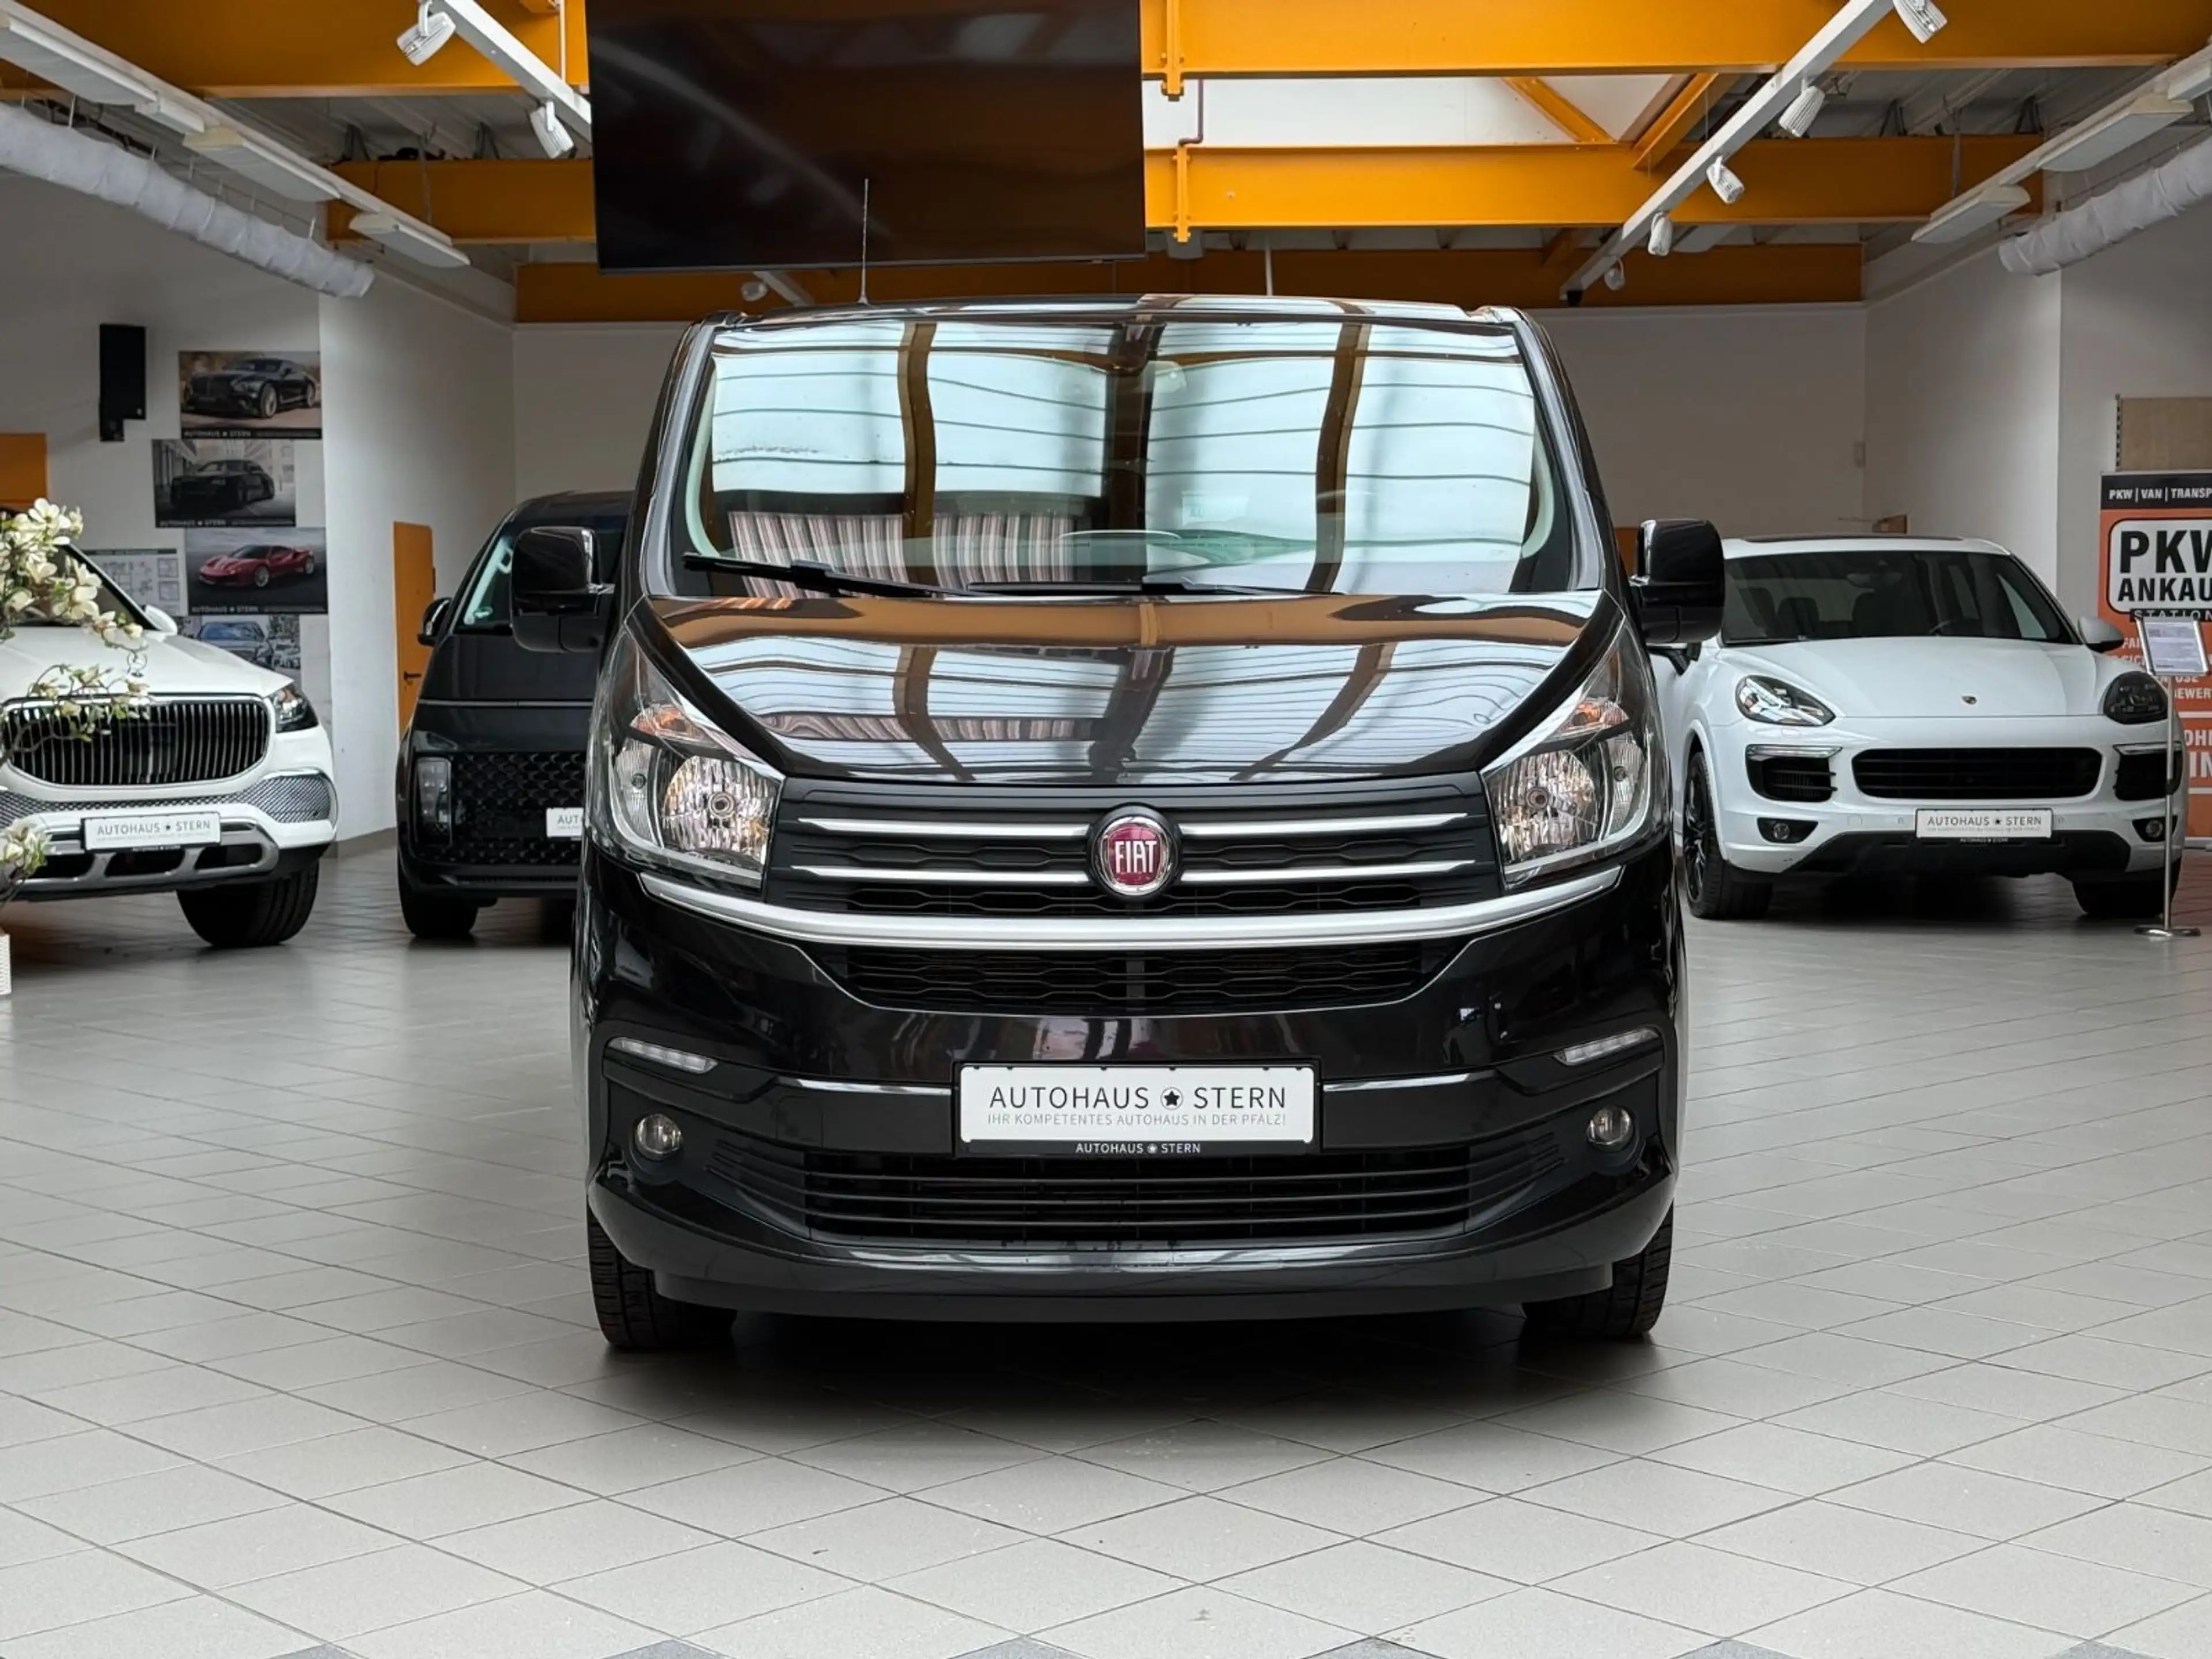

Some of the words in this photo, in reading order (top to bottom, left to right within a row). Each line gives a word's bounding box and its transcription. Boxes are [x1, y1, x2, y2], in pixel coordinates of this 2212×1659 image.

[2109, 488, 2133, 499] PKW
[2141, 488, 2162, 499] VAN
[2170, 487, 2212, 498] TRANSP
[97, 822, 160, 835] AUTOHAUS
[176, 820, 210, 832] STERN
[1927, 816, 1990, 826] AUTOHAUS
[2005, 816, 2041, 826] STERN
[1115, 840, 1158, 873] FIAT
[989, 1086, 1149, 1109] AUTOHAUS
[1194, 1086, 1285, 1109] STERN
[987, 1113, 1010, 1125] IHR
[1014, 1113, 1113, 1125] KOMPETENTES
[1116, 1113, 1189, 1125] AUTOHAUS
[1194, 1113, 1207, 1125] IN
[1211, 1113, 1237, 1125] DER
[1242, 1113, 1286, 1126] PFALZ!
[1075, 1143, 1143, 1154] AUTOHAUS
[1161, 1143, 1201, 1154] STERN
